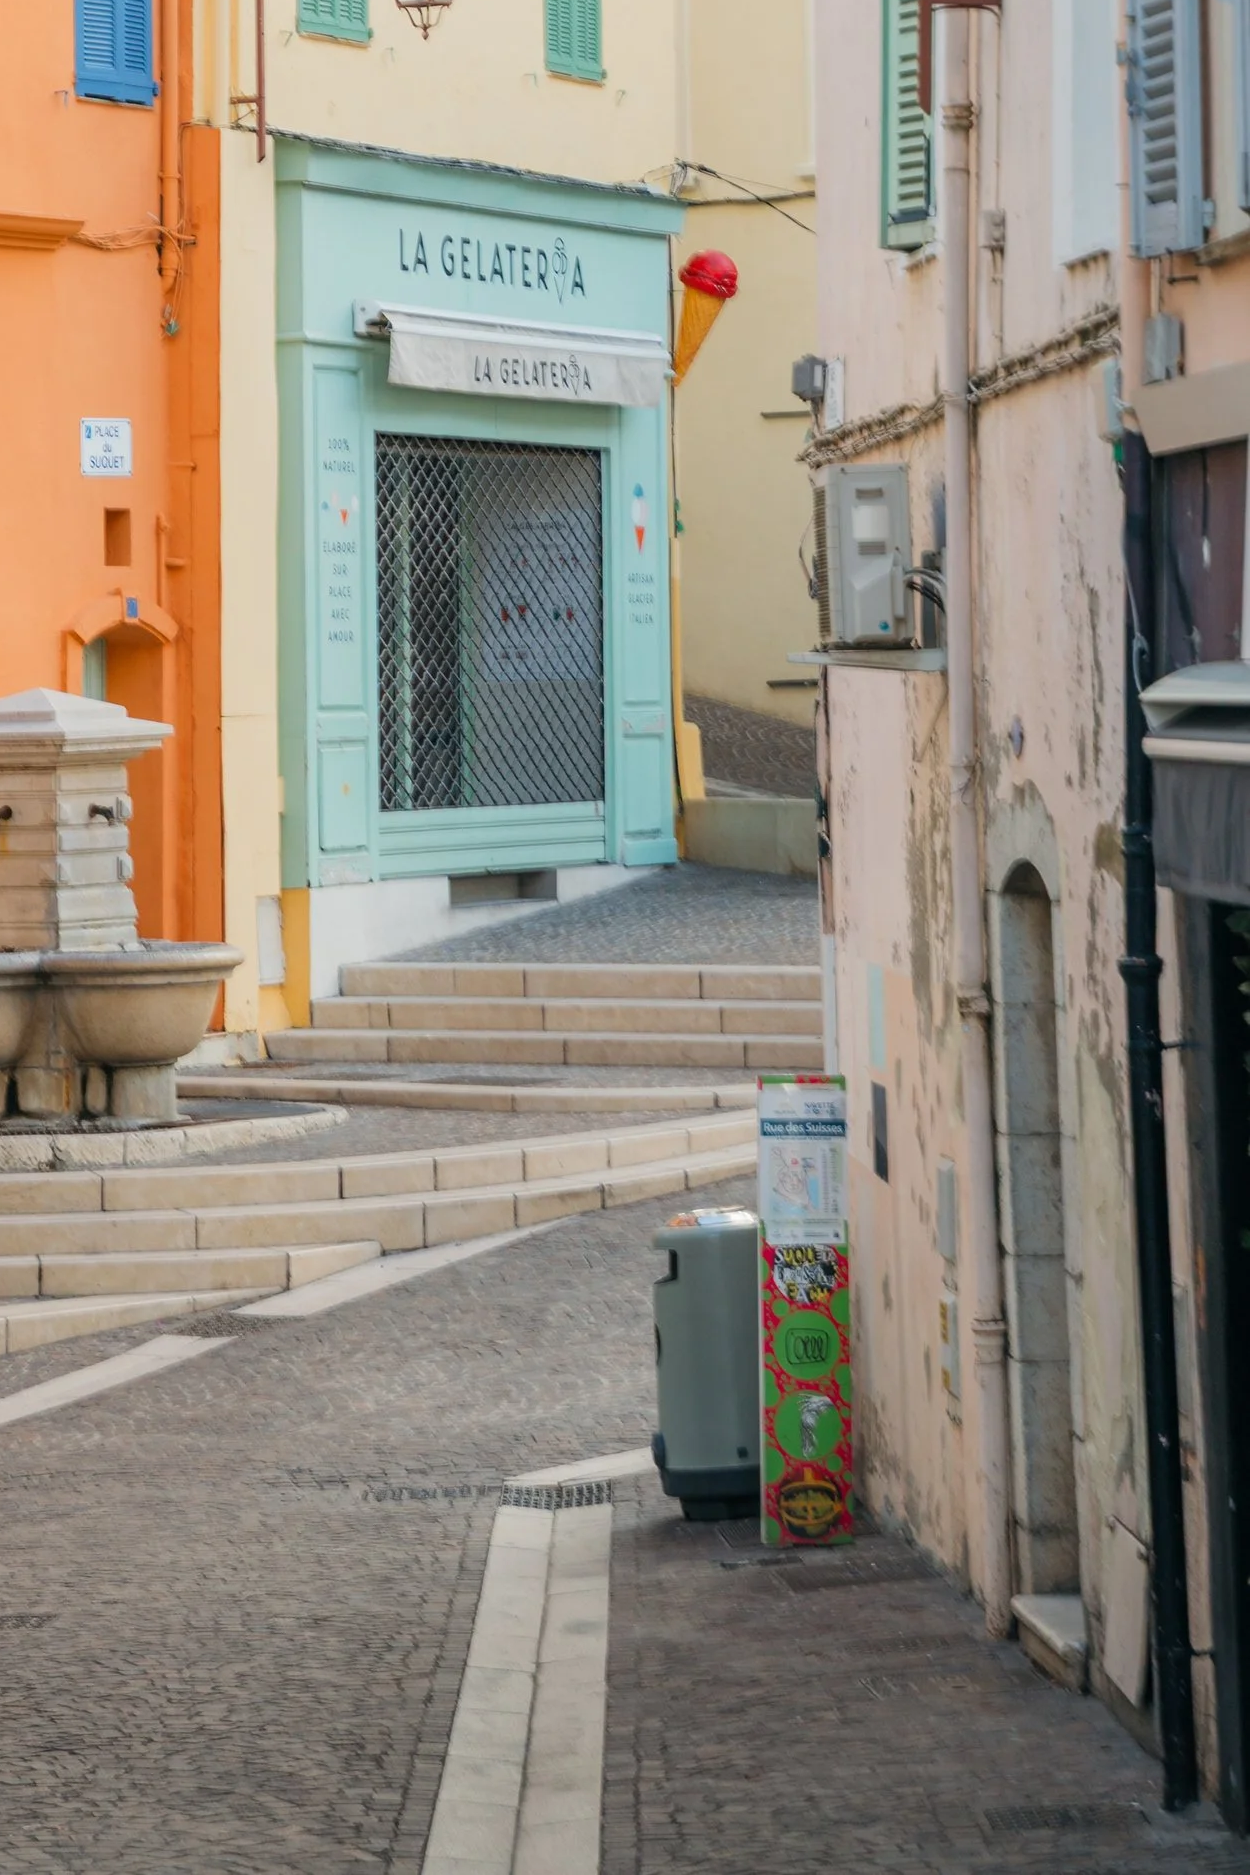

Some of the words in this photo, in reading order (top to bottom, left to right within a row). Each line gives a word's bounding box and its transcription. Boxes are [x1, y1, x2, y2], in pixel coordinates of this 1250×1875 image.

[399, 228, 429, 274] LA
[474, 356, 492, 383] LA
[94, 425, 119, 438] PLACE
[102, 441, 112, 453] du
[328, 438, 350, 452] 100%
[90, 455, 125, 469] SUQUET
[322, 460, 356, 474] NATUREL
[333, 563, 348, 576] SUR
[329, 585, 352, 599] PLACE
[331, 608, 350, 620] AVEC
[328, 629, 355, 643] AMOUR
[763, 1122, 783, 1133] Rue
[785, 1121, 805, 1133] des
[805, 1121, 843, 1133] Suisses
